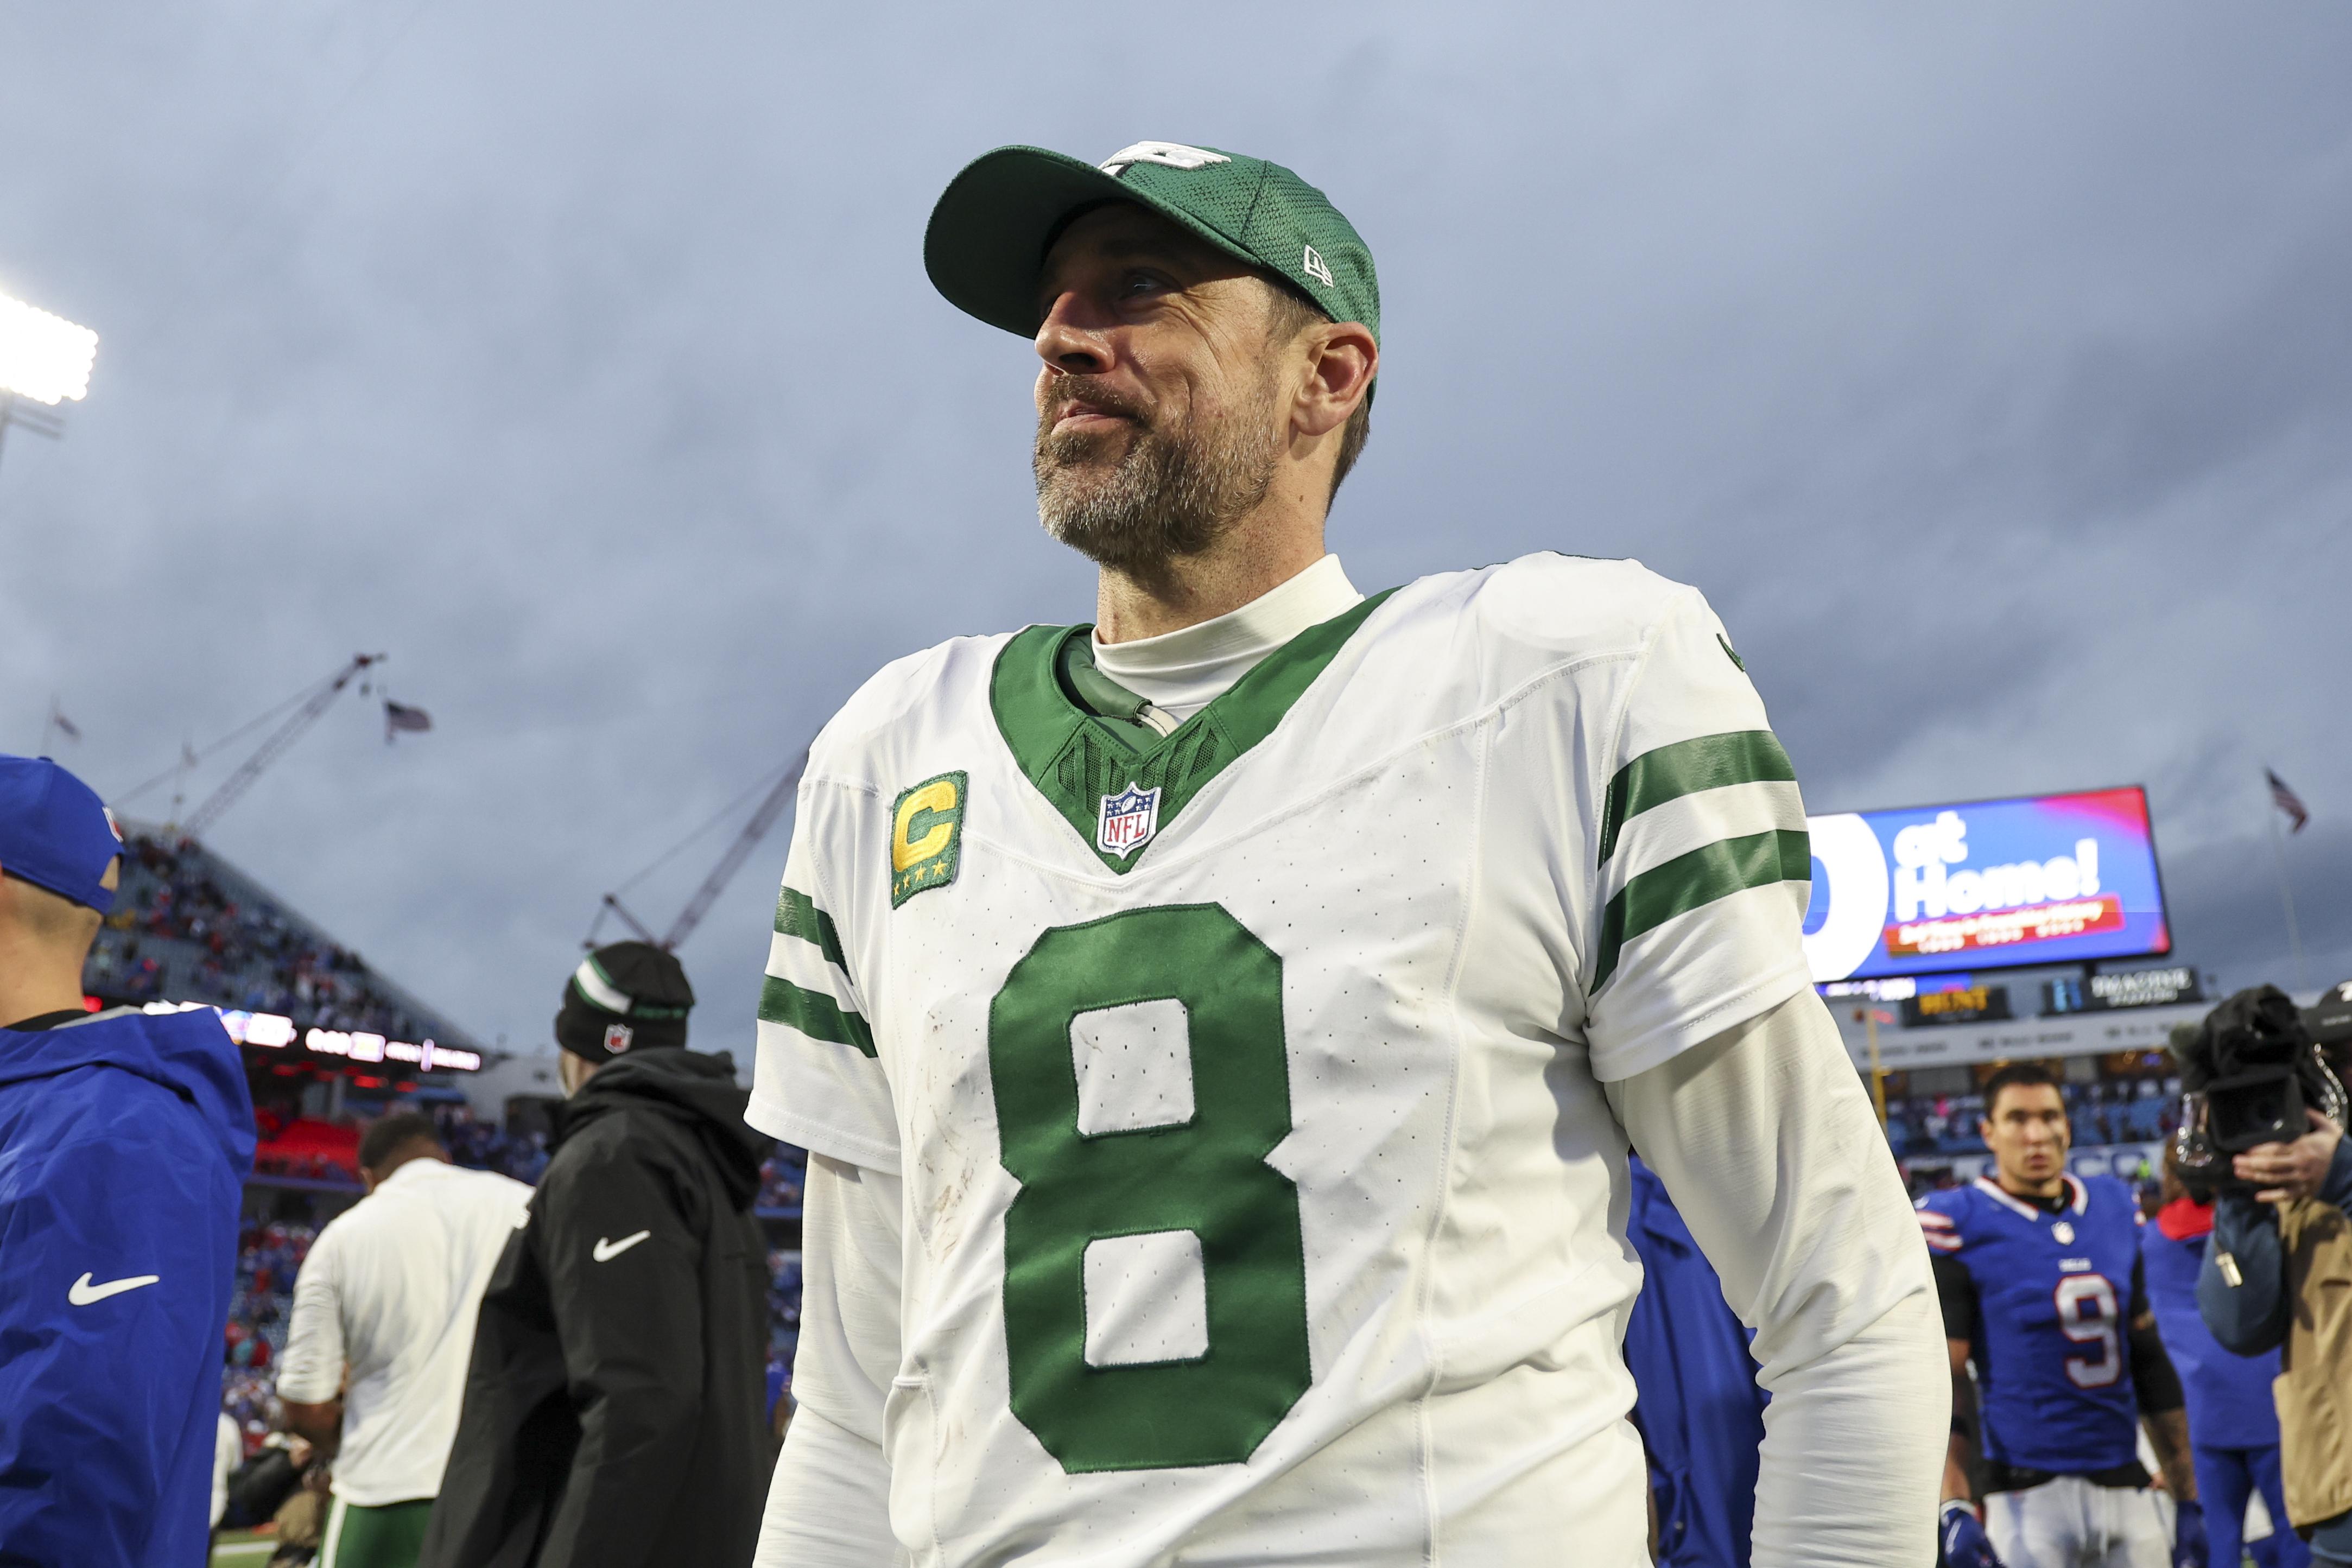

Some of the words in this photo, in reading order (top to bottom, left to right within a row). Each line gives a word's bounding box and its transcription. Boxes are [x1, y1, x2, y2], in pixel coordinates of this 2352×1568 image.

[893, 781, 957, 873] C
[1107, 814, 1145, 843] NFL
[1894, 810, 1968, 869] at
[1894, 837, 2101, 923] Home!
[988, 902, 1313, 1475] 8
[2055, 1273, 2121, 1389] 9
